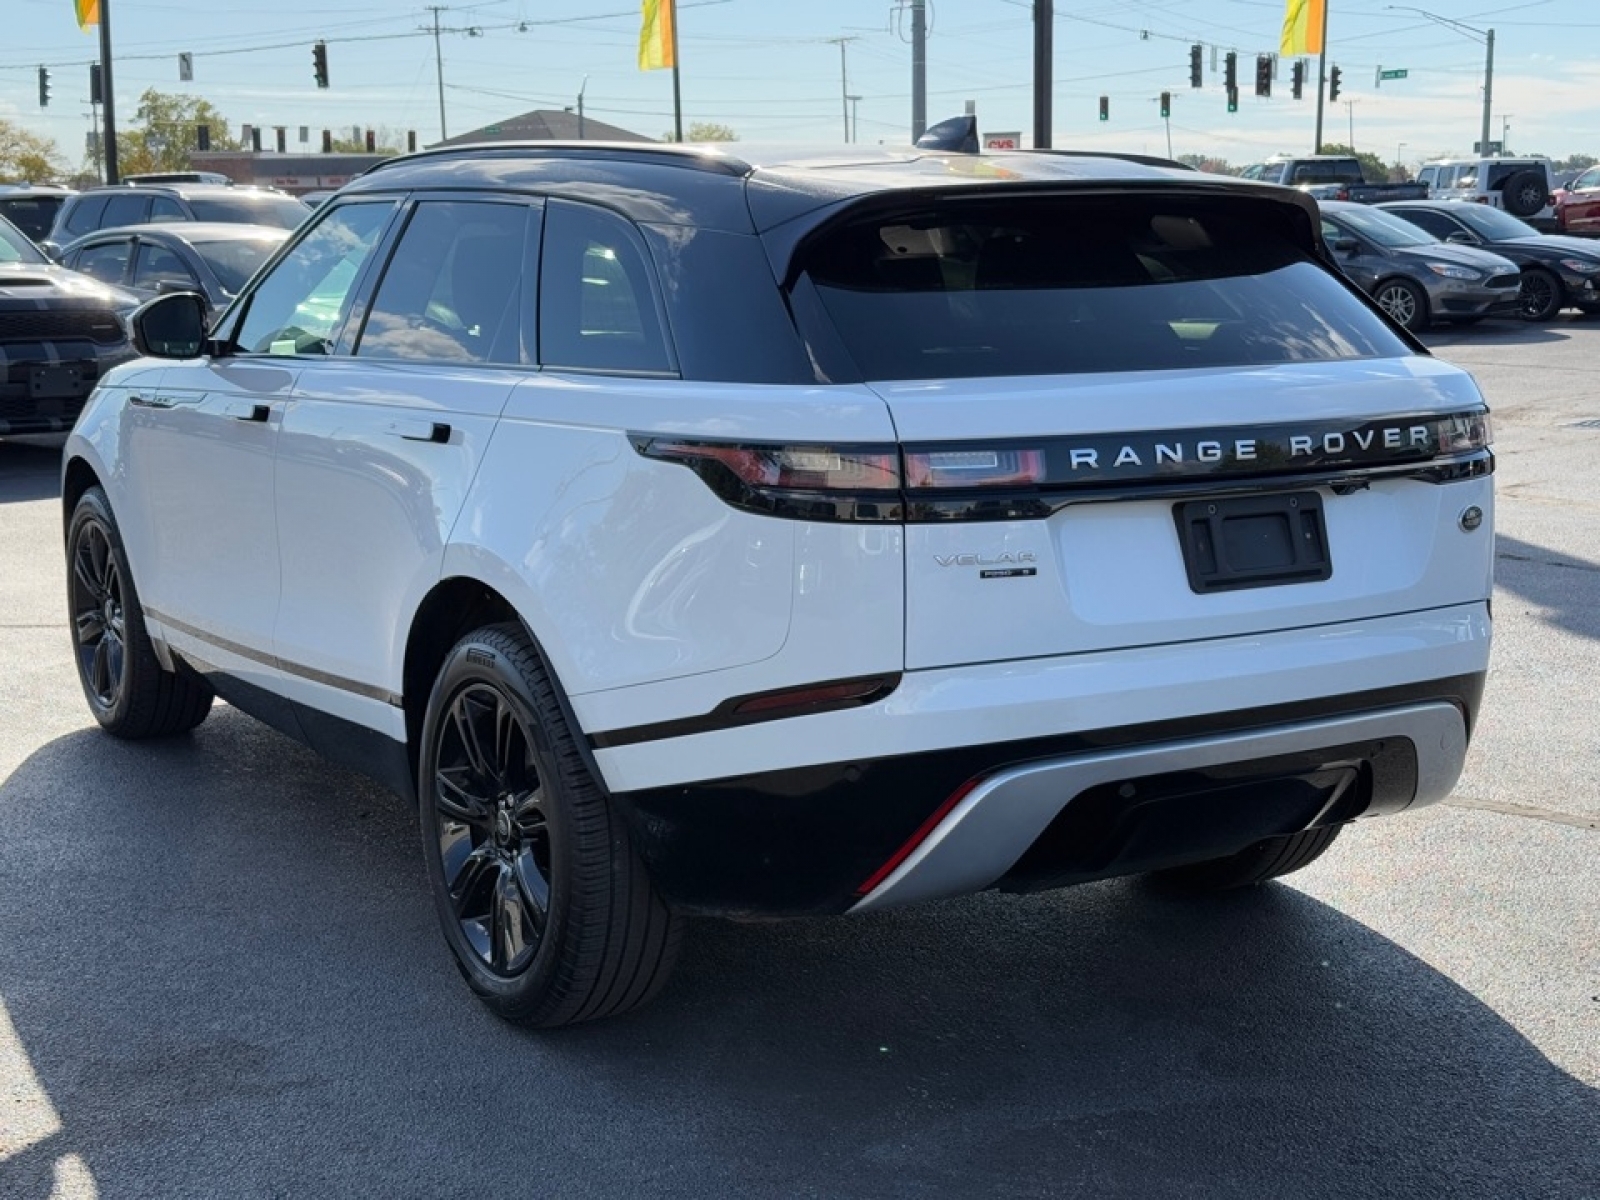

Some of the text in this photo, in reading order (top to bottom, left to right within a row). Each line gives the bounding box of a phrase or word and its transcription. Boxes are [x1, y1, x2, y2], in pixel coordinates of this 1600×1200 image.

[1069, 426, 1428, 471] RANGE ROVER
[933, 551, 1037, 567] VELAR
